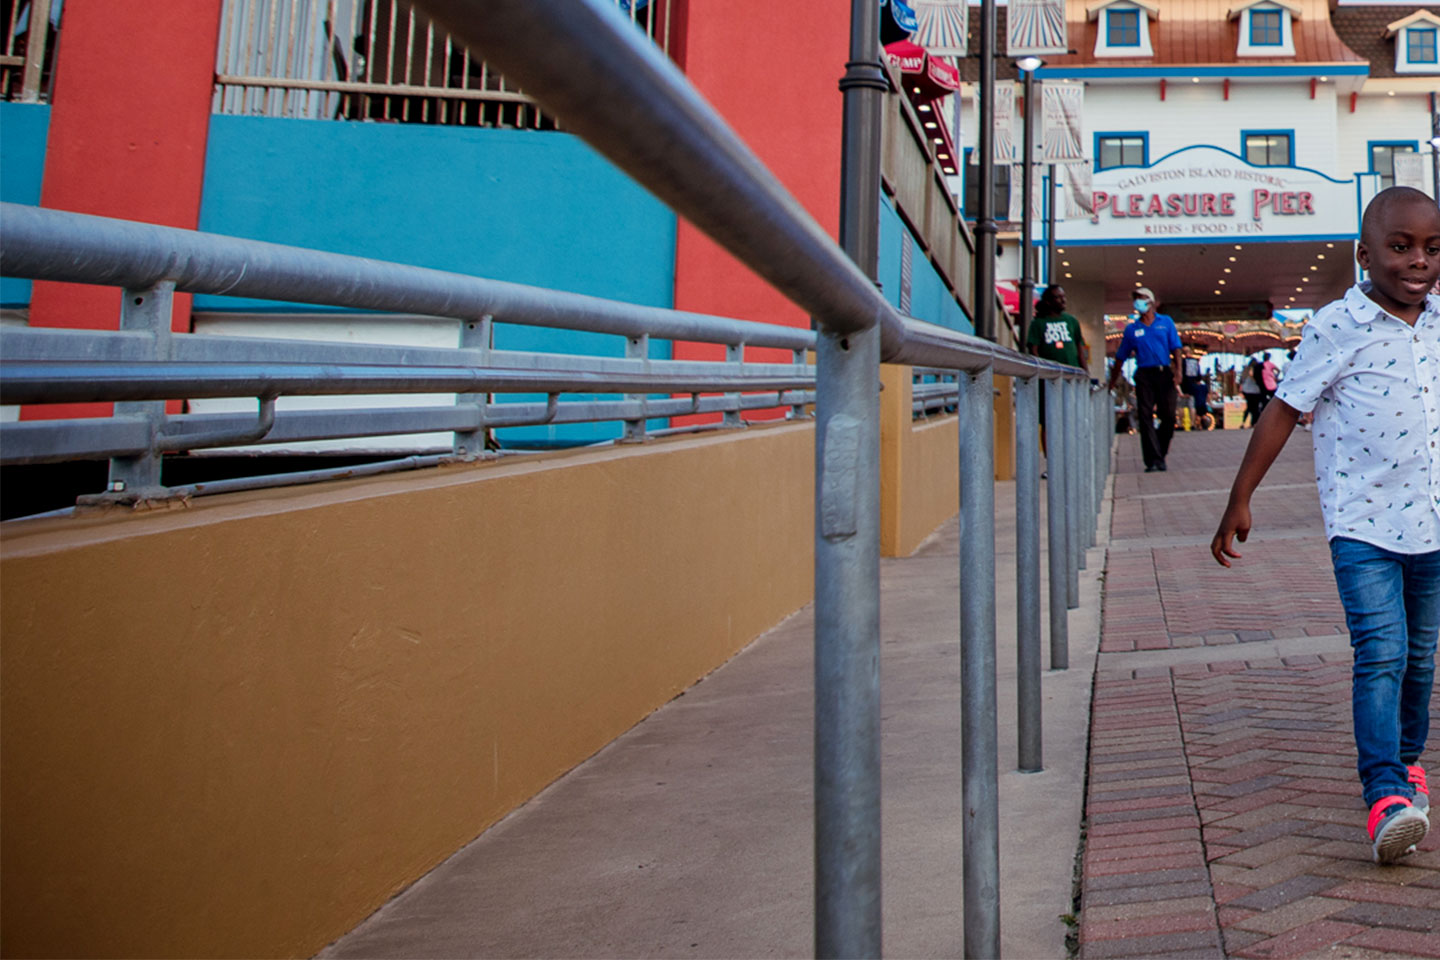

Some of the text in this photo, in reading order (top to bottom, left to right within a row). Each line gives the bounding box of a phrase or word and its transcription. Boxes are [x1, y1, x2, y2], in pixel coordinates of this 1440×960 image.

[1117, 167, 1288, 190] GALVESTON ISLAND HISTORIC
[1091, 188, 1316, 224] PLEASURE PIER
[1144, 222, 1264, 235] RIDES FOOD FUN
